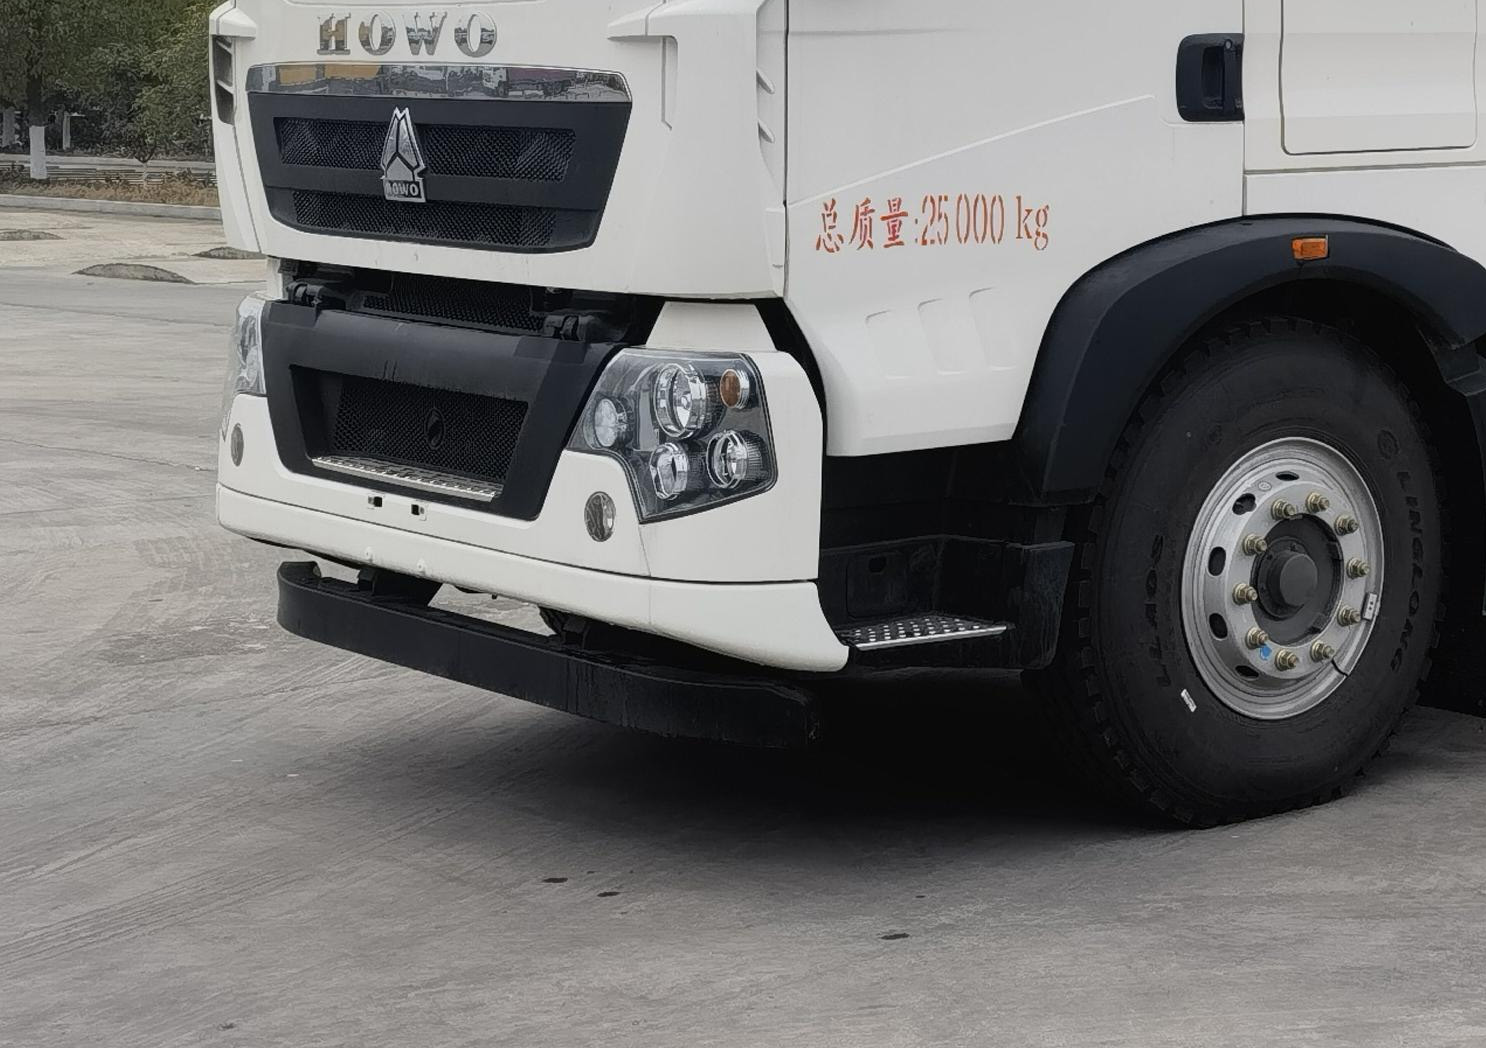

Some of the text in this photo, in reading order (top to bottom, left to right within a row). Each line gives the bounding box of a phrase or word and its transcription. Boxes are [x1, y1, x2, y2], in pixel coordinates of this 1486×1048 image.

[316, 10, 498, 58] HOWO
[385, 182, 419, 197] HOWO
[1015, 195, 1050, 251] kg
[1390, 471, 1424, 673] LINGLONG
